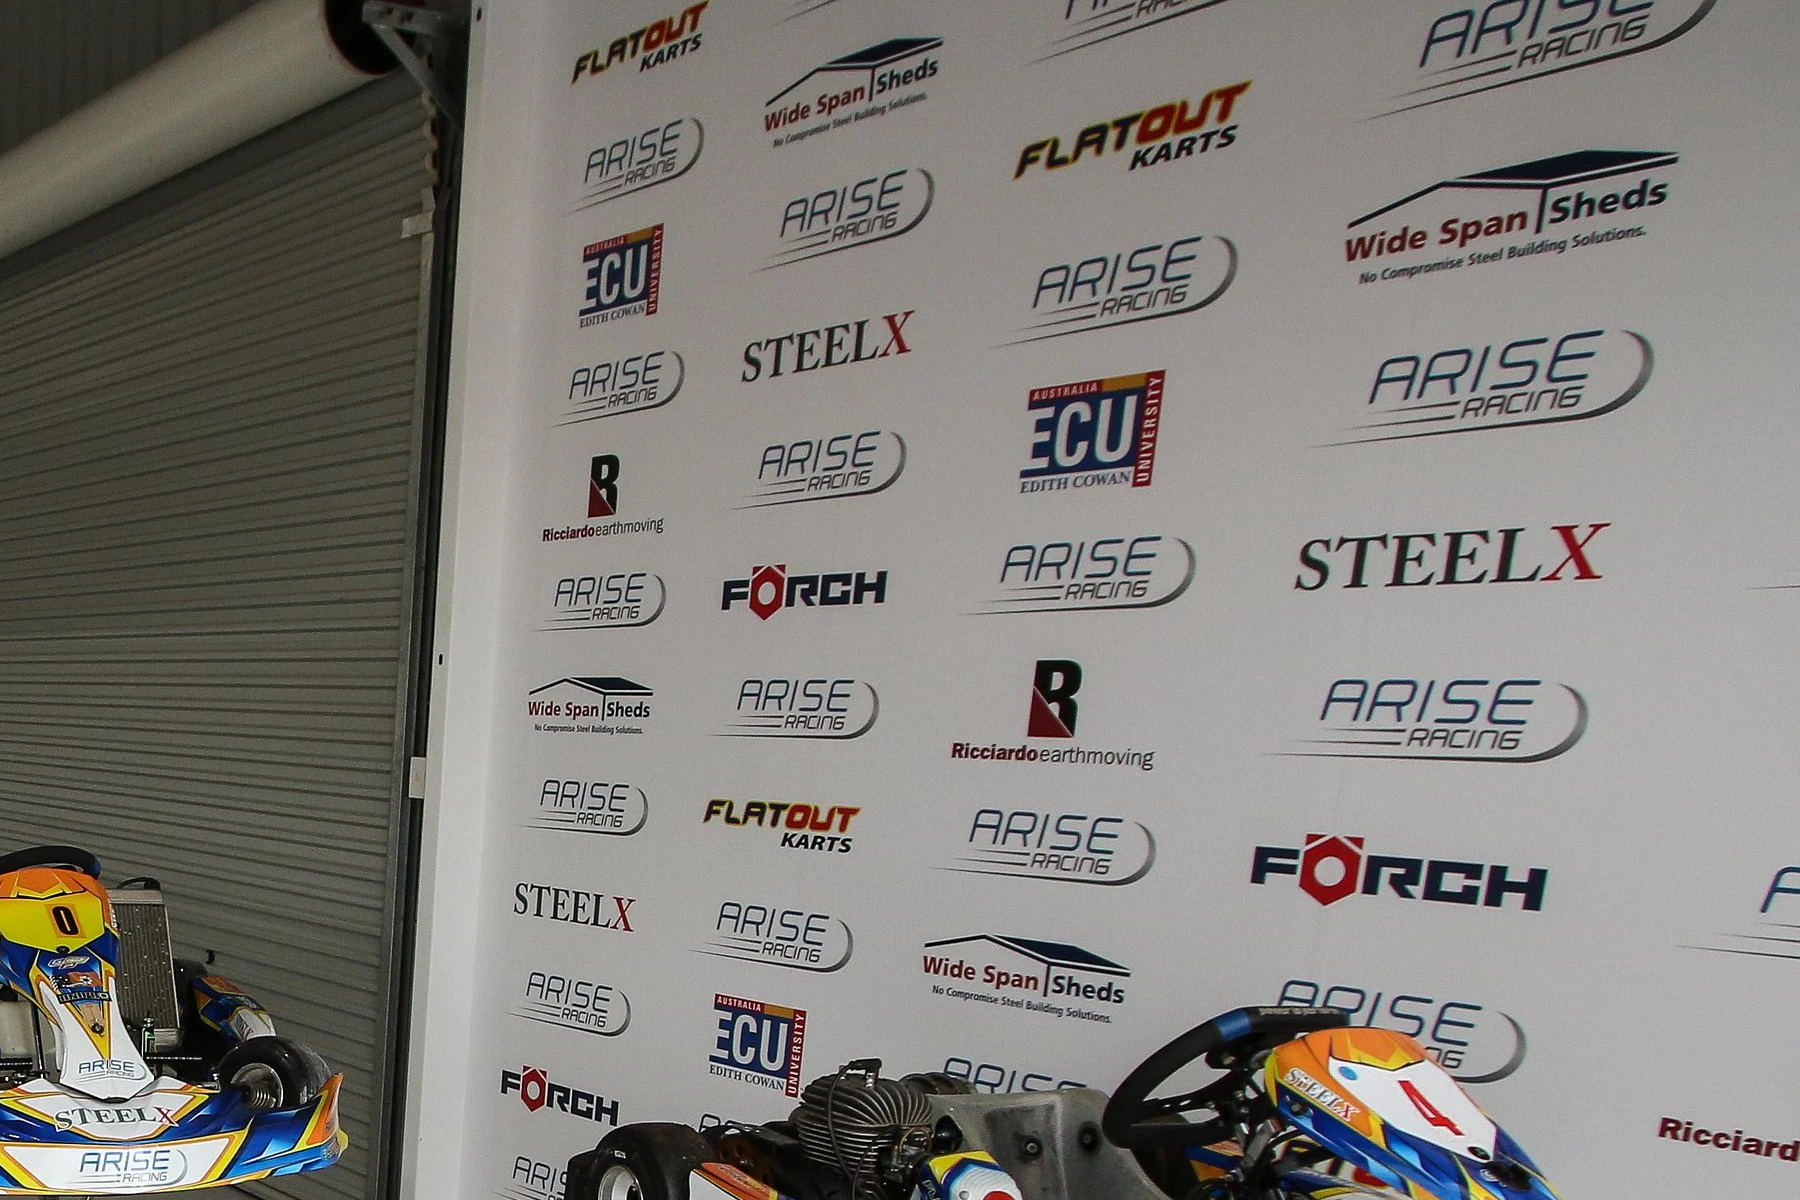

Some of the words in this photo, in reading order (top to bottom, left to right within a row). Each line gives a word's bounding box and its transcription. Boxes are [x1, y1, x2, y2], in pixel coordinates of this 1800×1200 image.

[570, 4, 709, 85] FLATOUT
[639, 34, 703, 73] KARTS
[1517, 15, 1650, 68] RACING
[763, 100, 811, 133] Wide
[816, 85, 866, 116] Span
[876, 57, 938, 94] Sheds
[1013, 79, 1252, 180] FLATOUT
[1128, 123, 1238, 171] KARTS
[585, 120, 683, 183] ARISE
[624, 156, 675, 186] RACING
[780, 168, 909, 237] ARISE
[830, 212, 898, 244] RACING
[1344, 223, 1427, 262] Wide
[1439, 211, 1528, 249] Span
[1548, 180, 1669, 224] Sheds
[580, 243, 649, 310] ECU
[1032, 235, 1204, 309] ARISE
[1359, 268, 1376, 284] No
[1380, 255, 1463, 281] Compromise
[1468, 248, 1503, 265] Steel
[1507, 237, 1566, 261] Building
[580, 314, 610, 328] EDITH
[611, 303, 645, 321] COWAN
[1100, 283, 1188, 318] RACING
[741, 311, 916, 383] STEELX
[570, 352, 665, 399] ARISE
[1369, 330, 1604, 405] ARISE
[608, 386, 657, 408] RACING
[1031, 380, 1100, 401] AUSTRALIA
[1461, 386, 1586, 420] RACING
[1027, 393, 1139, 475] ECU
[1133, 374, 1162, 483] UNIVERSITY
[758, 430, 882, 479] ARISE
[808, 468, 870, 489] RACING
[1020, 474, 1070, 493] EDITH
[1073, 470, 1131, 488] COWAN
[1000, 535, 1164, 583] ARISE
[1295, 522, 1611, 591] STEELX
[554, 573, 647, 607] ARISE
[1064, 582, 1148, 601] RACING
[591, 604, 641, 621] RACING
[528, 701, 561, 718] Wide
[565, 701, 599, 722] Span
[607, 702, 651, 718] Sheds
[737, 679, 856, 713] ARISE
[1320, 679, 1542, 725] ARISE
[784, 713, 846, 730] RACING
[1406, 728, 1523, 751] RACING
[540, 780, 630, 811] ARISE
[576, 811, 623, 828] RACING
[703, 798, 861, 833] FLATOUT
[968, 808, 1124, 854] ARISE
[780, 832, 853, 853] KARTS
[1030, 853, 1111, 875] RACING
[52, 905, 80, 935] 0
[513, 882, 636, 933] STEELX
[717, 902, 831, 947] ARISE
[762, 940, 821, 963] RACING
[525, 972, 614, 1013] ARISE
[922, 955, 977, 982] Wide
[981, 963, 1039, 991] Span
[1053, 976, 1125, 1005] Sheds
[562, 1006, 607, 1029] RACING
[716, 995, 762, 1012] AUSTRALIA
[932, 984, 946, 996] No
[948, 987, 998, 1006] Compromise
[1001, 997, 1026, 1010] Steel
[1029, 999, 1064, 1017] Building
[710, 1009, 787, 1071] ECU
[786, 1012, 806, 1096] UNIVERSITY
[78, 1060, 135, 1074] ARISE
[709, 1064, 751, 1082] EDITH
[752, 1073, 785, 1091] COWAN
[1284, 1067, 1361, 1123] STEELX
[1397, 1080, 1465, 1136] 4
[55, 1106, 179, 1131] STEELX
[80, 1150, 171, 1172] ARISE
[123, 1172, 168, 1182] RACING
